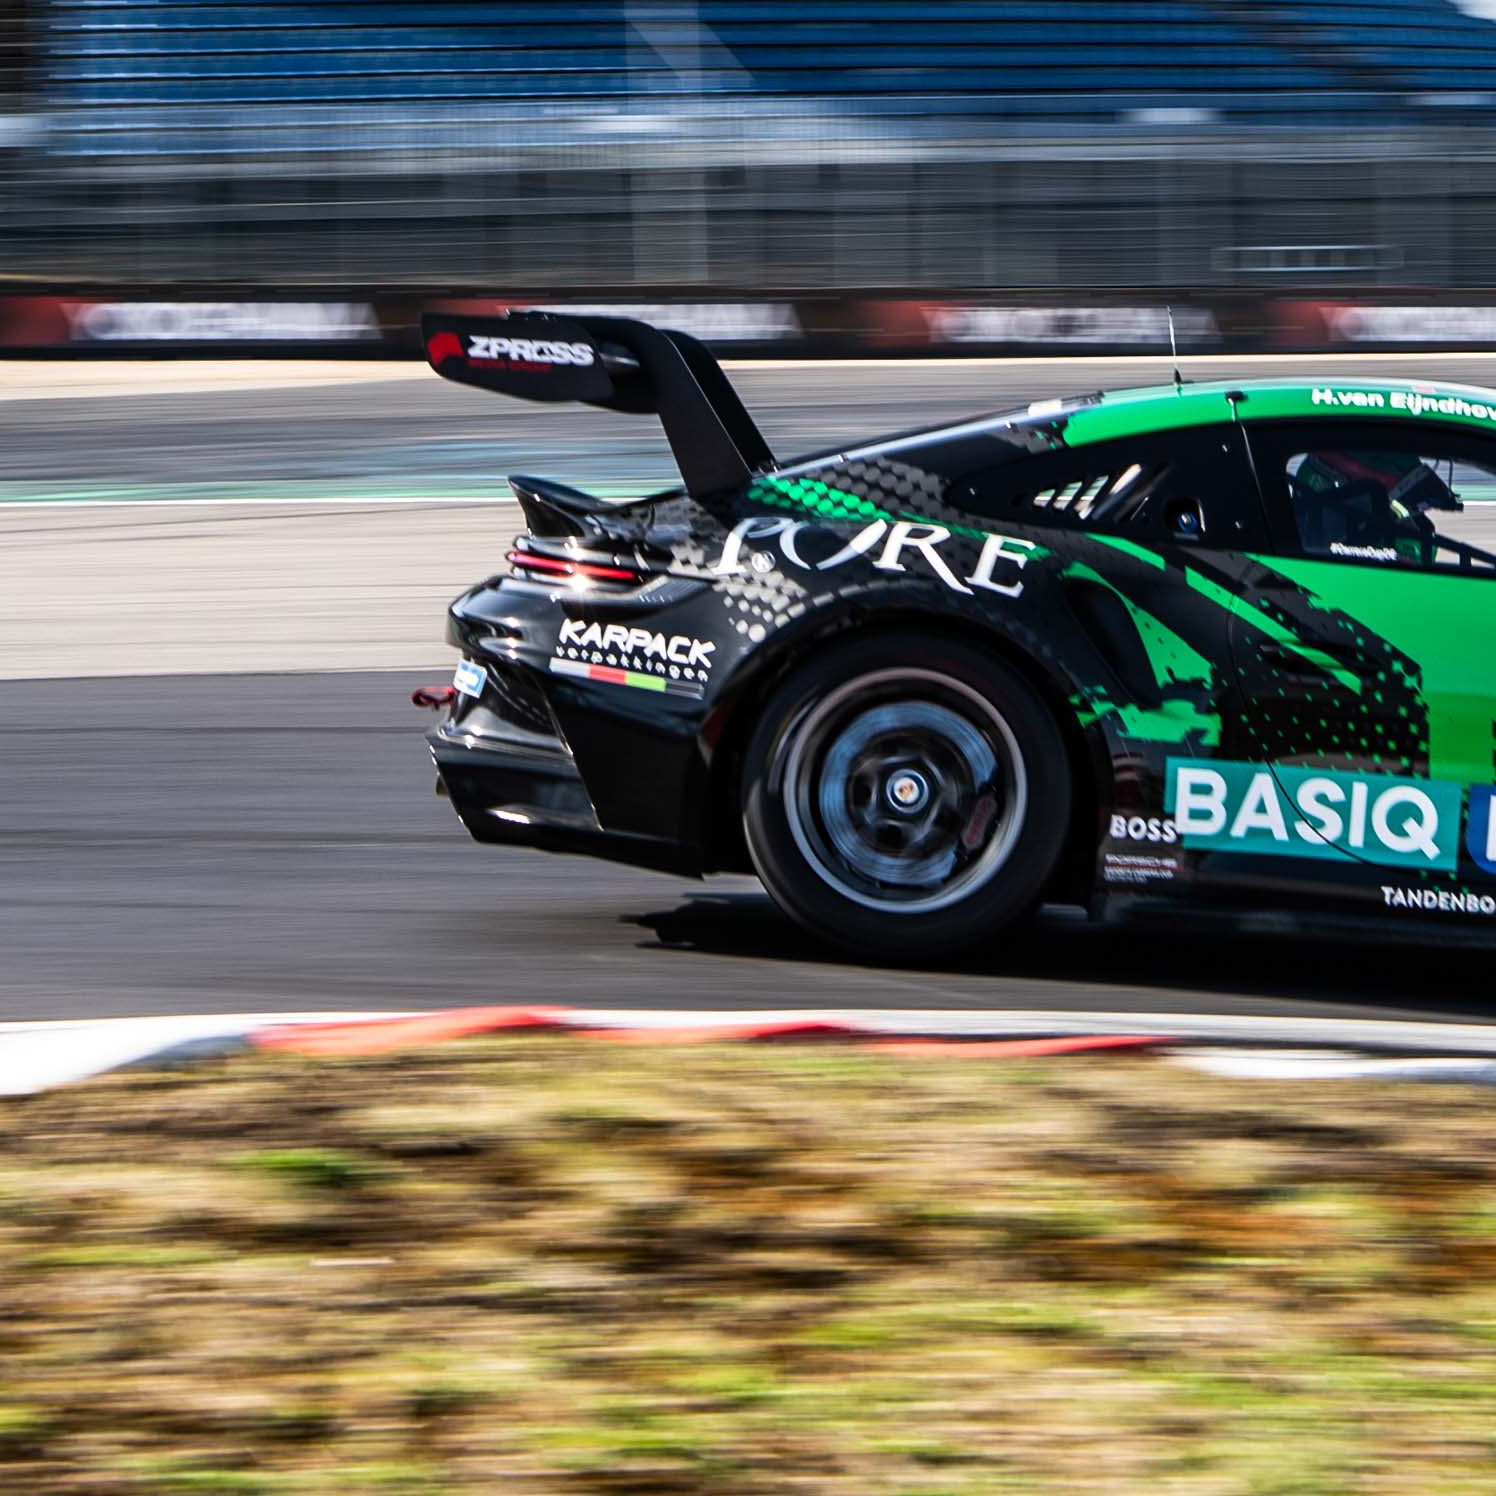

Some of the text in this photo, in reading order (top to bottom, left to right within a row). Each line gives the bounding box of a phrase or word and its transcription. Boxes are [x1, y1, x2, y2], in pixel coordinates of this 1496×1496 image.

[1311, 388, 1385, 408] H.van
[558, 617, 717, 669] KARPACK
[1109, 813, 1177, 844] BOSS
[1175, 767, 1440, 861] BASIQ
